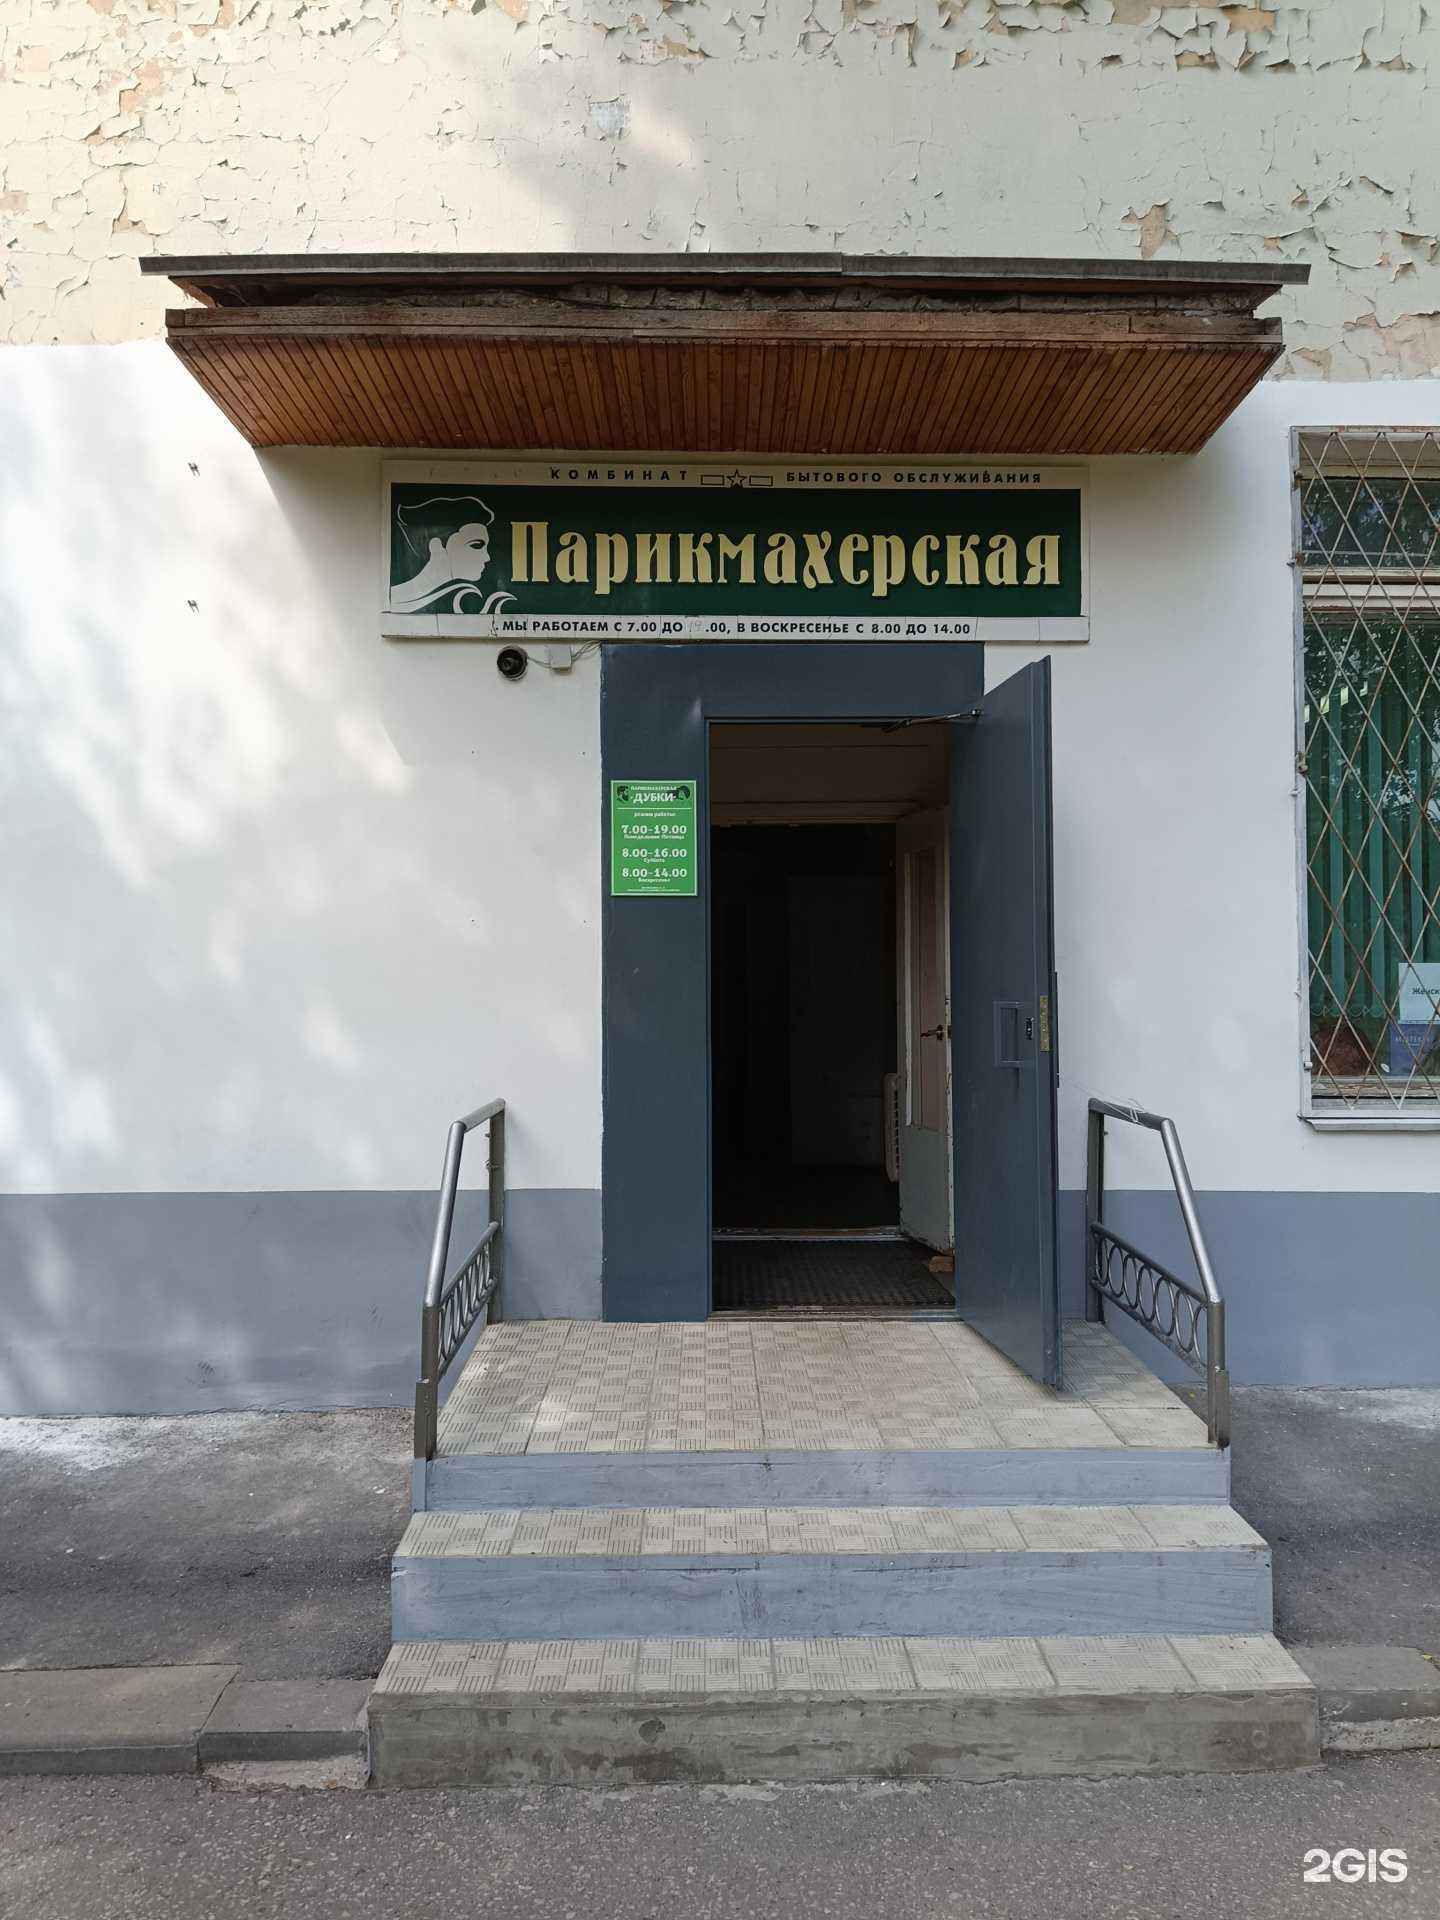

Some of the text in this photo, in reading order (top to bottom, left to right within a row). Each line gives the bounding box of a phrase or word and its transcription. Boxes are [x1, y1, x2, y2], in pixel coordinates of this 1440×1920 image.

[550, 467, 1041, 483] КОМБИНАТ БЫТОВОГО ОБСЛУЖИВАНИЯ
[510, 521, 1061, 597] Парикмахерская
[503, 621, 527, 632] МЫ
[532, 621, 608, 632] РАБОТАЕМ
[614, 621, 622, 632] С
[627, 621, 657, 632] 7.00
[662, 622, 683, 634] ДО
[737, 622, 745, 632] В
[751, 622, 849, 634] ВОСКРЕСЕНЬЕ
[856, 623, 864, 634] С
[871, 623, 901, 634] 8.00
[906, 624, 927, 636] ДО
[933, 623, 970, 634] 14.00
[621, 824, 688, 834] 7.00-19.00
[621, 848, 688, 858] 8.00-16.00
[621, 868, 688, 878] 8.00-14.00
